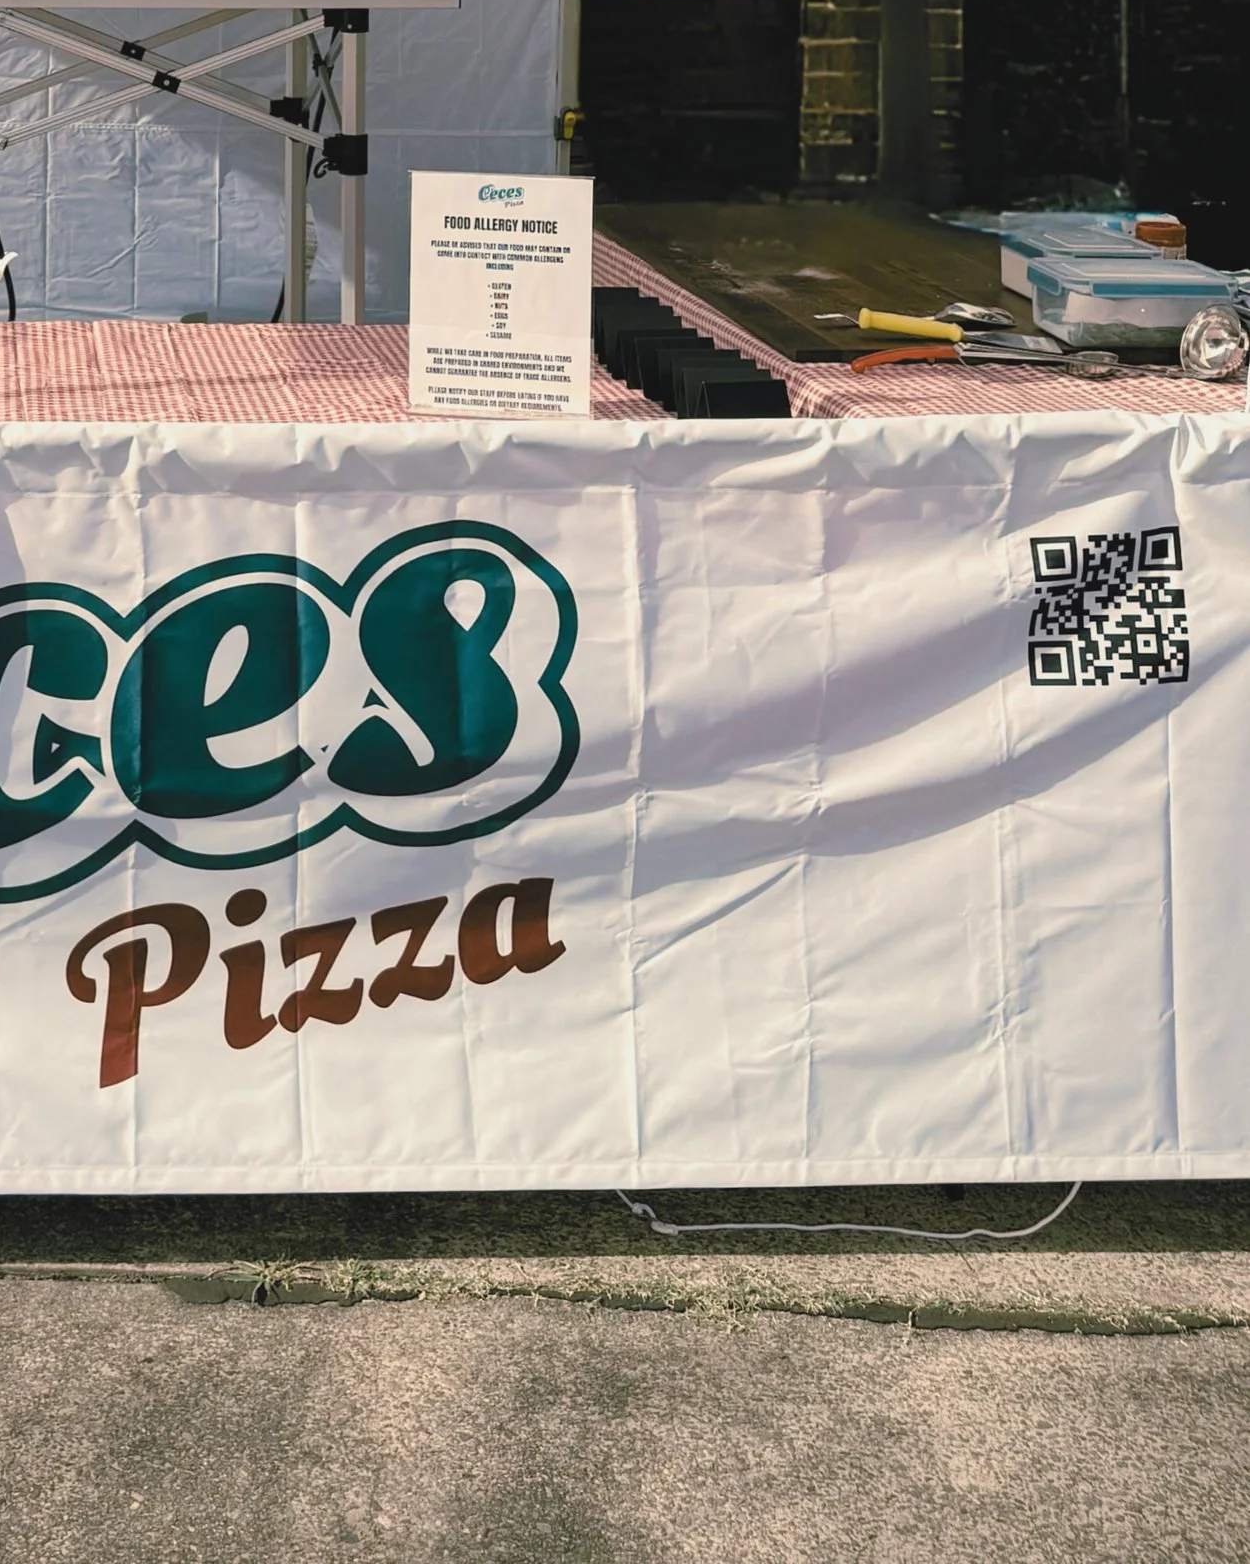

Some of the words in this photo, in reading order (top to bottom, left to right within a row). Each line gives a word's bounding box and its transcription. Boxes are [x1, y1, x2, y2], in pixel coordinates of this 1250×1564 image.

[478, 184, 524, 203] Ceces
[444, 216, 470, 229] FOOD
[474, 218, 518, 232] ALLERGY
[522, 220, 558, 234] NOTICE
[431, 240, 450, 248] PLEASE
[483, 242, 496, 250] THAT
[539, 245, 561, 253] CONTAIN
[534, 255, 563, 263] ALLERGENS
[494, 292, 509, 300] DAIRY
[495, 302, 508, 310] NUTS
[544, 354, 553, 362] ALL
[445, 358, 471, 366] PREPARED
[544, 364, 555, 372] AND
[426, 366, 446, 374] CANNOT
[428, 386, 447, 394] PLEASE
[66, 876, 566, 1088] Pizza
